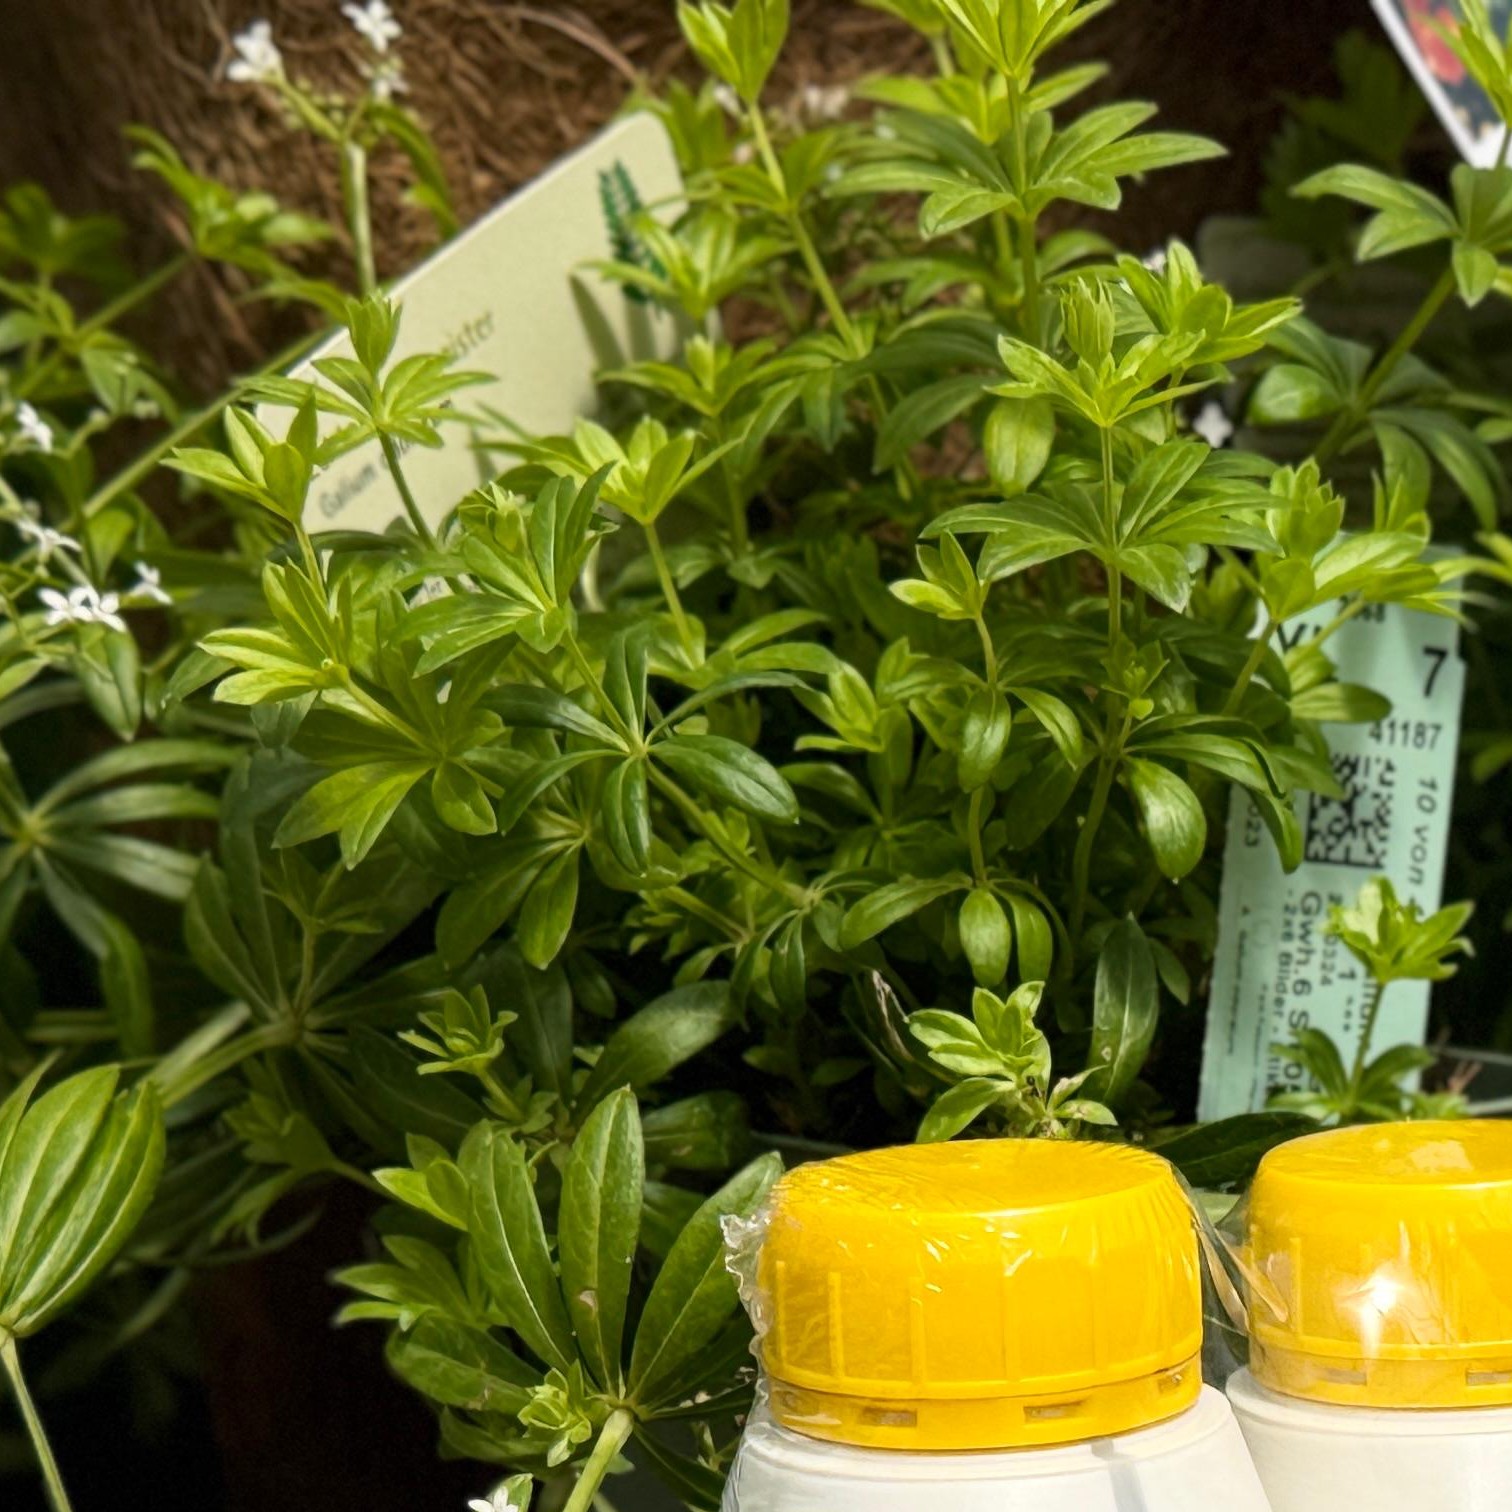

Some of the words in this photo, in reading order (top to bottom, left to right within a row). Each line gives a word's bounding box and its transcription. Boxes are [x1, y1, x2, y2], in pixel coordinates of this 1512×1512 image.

[1423, 646, 1448, 698] 7
[1416, 778, 1438, 814] 10
[1408, 825, 1430, 886] von
